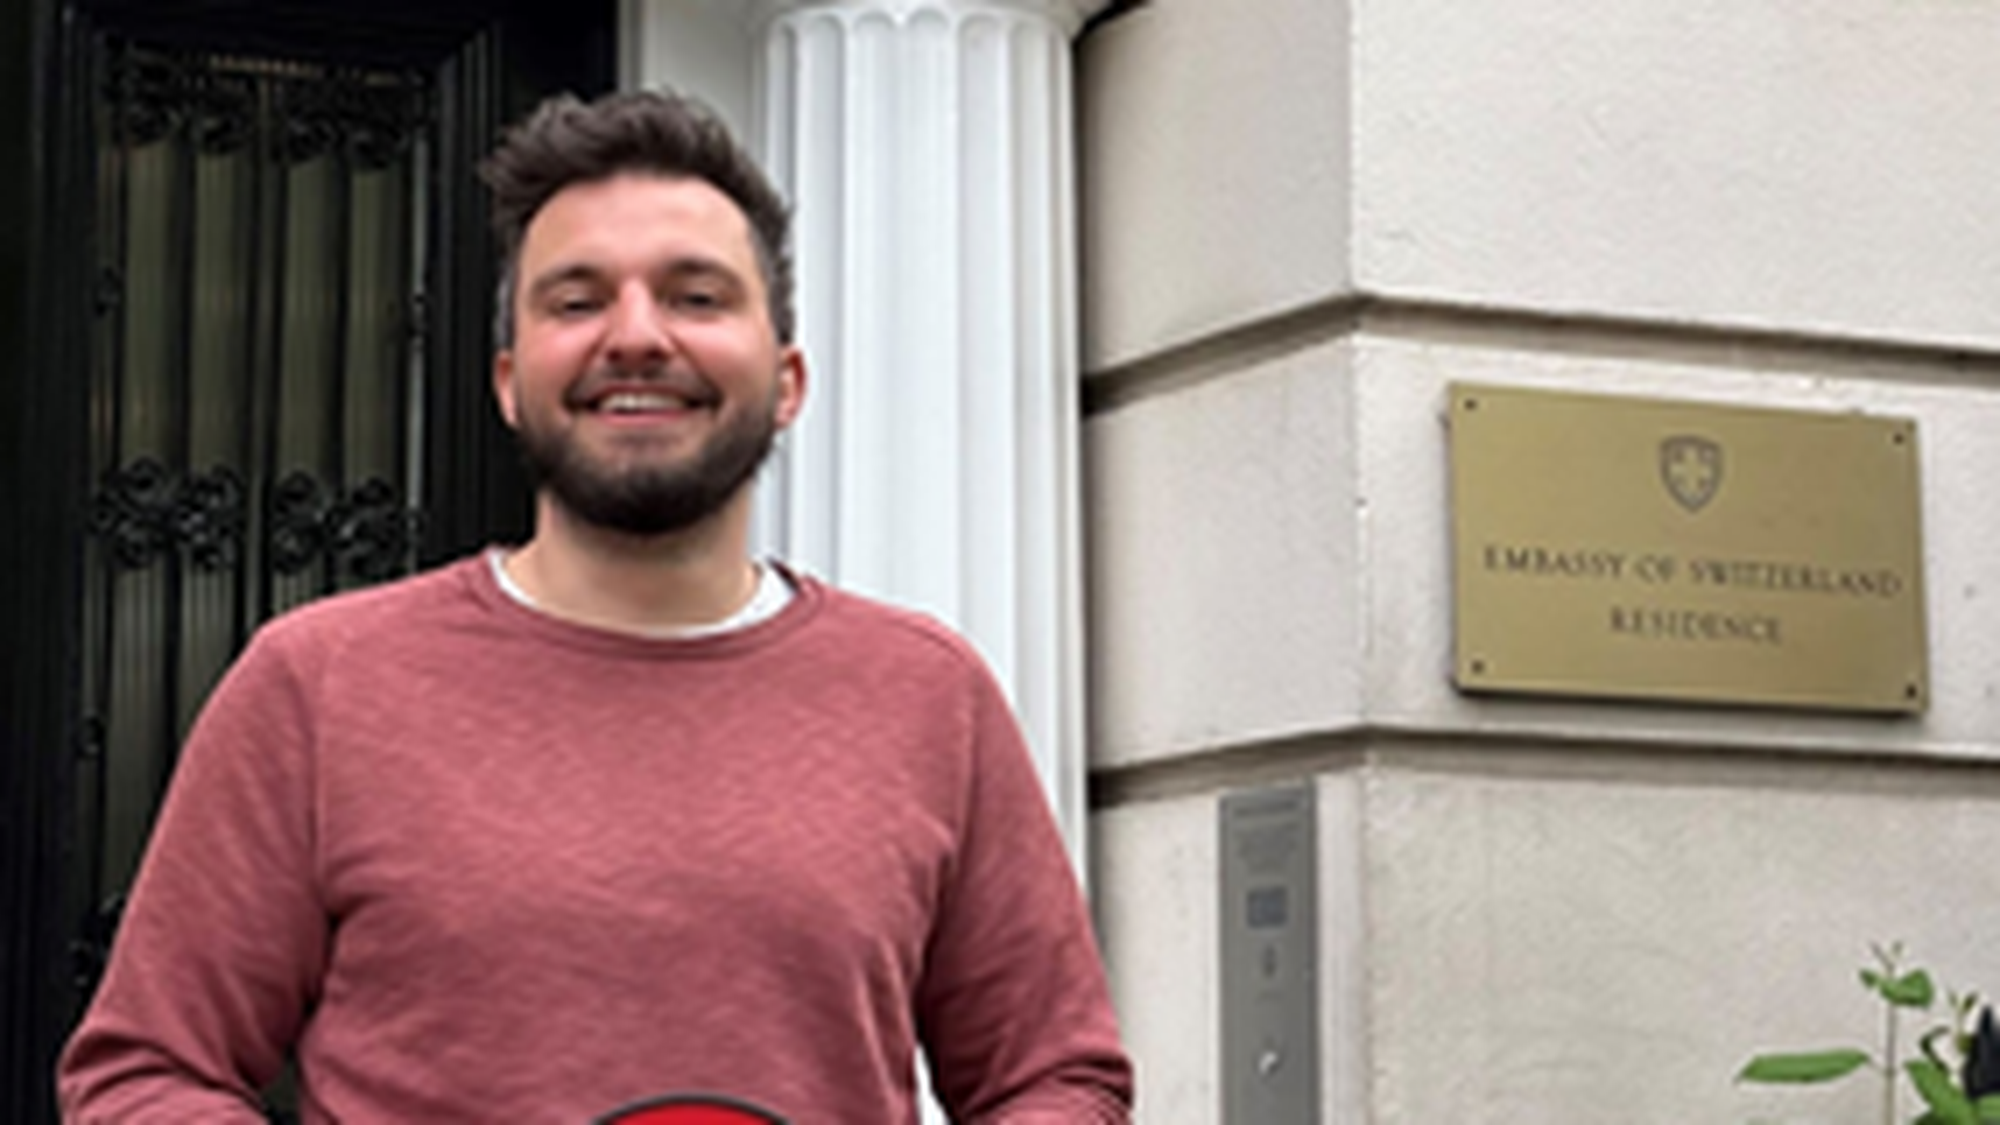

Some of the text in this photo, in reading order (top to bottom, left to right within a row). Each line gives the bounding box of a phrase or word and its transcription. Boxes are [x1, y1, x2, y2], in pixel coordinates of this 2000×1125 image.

[1484, 546, 1902, 599] EMBASSY OF SWITZERLAND
[1610, 605, 1783, 644] RESIDENCE
